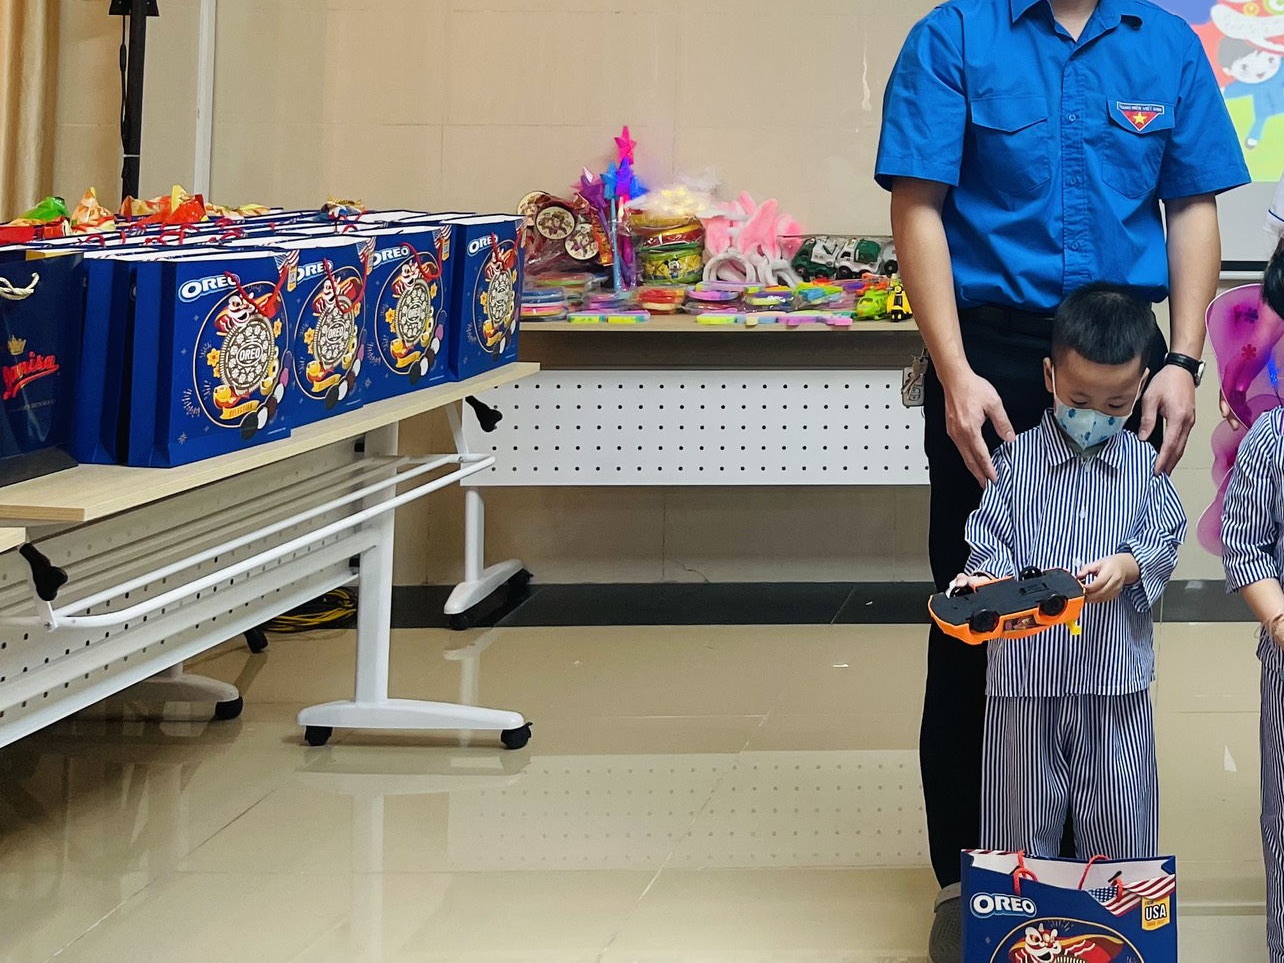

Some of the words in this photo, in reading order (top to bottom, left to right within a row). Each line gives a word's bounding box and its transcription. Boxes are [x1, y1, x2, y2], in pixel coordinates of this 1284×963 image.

[239, 348, 260, 361] OREO
[973, 894, 1035, 914] OREO
[1145, 904, 1166, 921] USA
